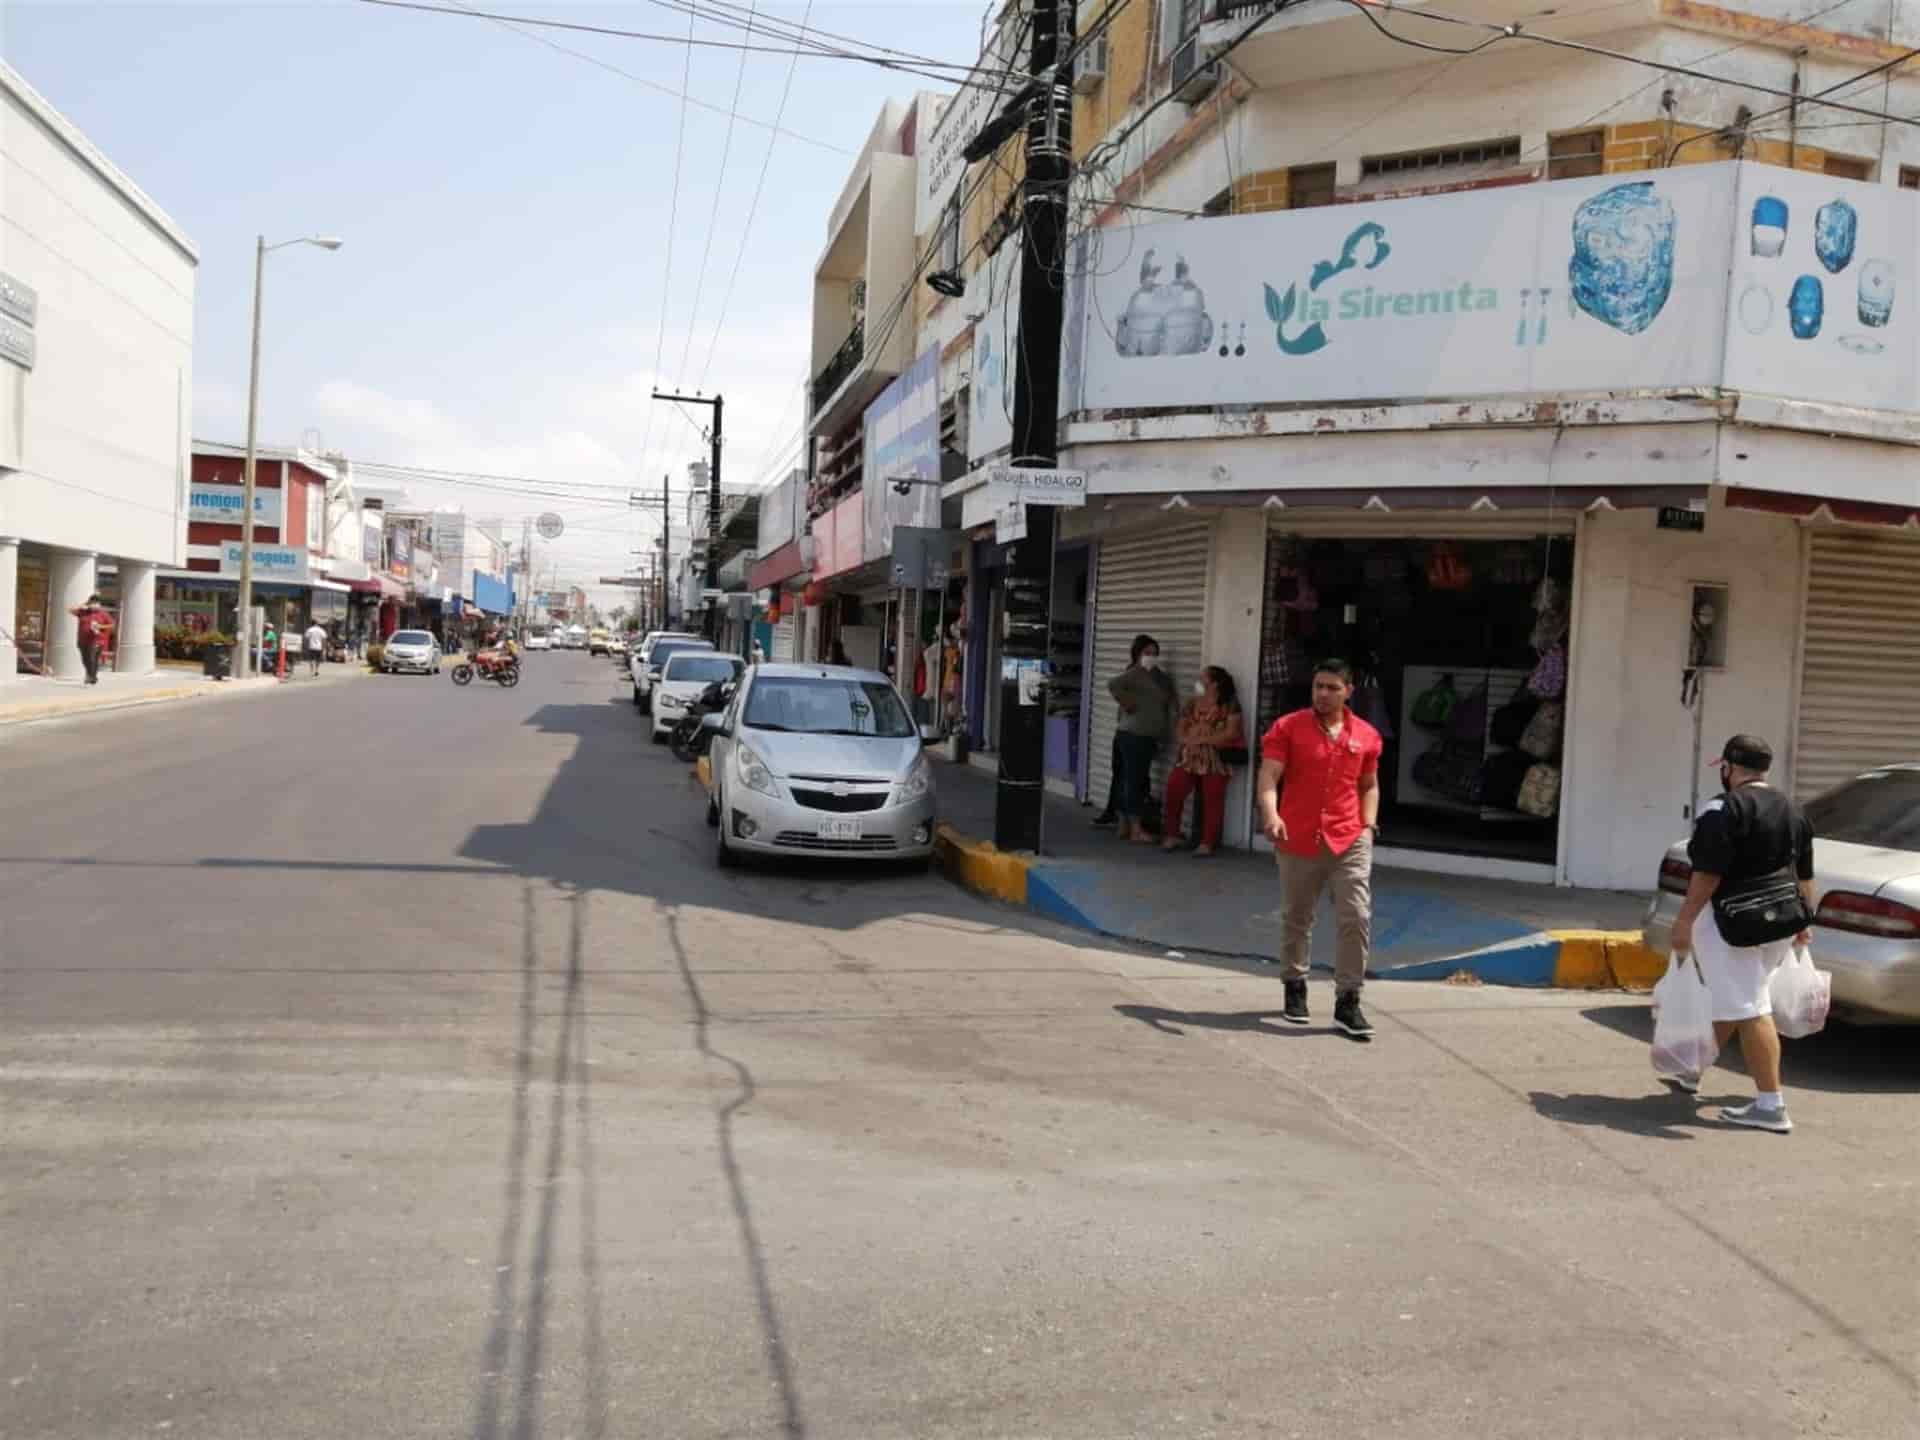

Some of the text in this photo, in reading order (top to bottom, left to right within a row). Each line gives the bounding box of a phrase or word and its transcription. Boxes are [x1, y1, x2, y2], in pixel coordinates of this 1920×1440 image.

[1297, 280, 1500, 322] la Sirenita
[1034, 473, 1082, 488] HIDALGO
